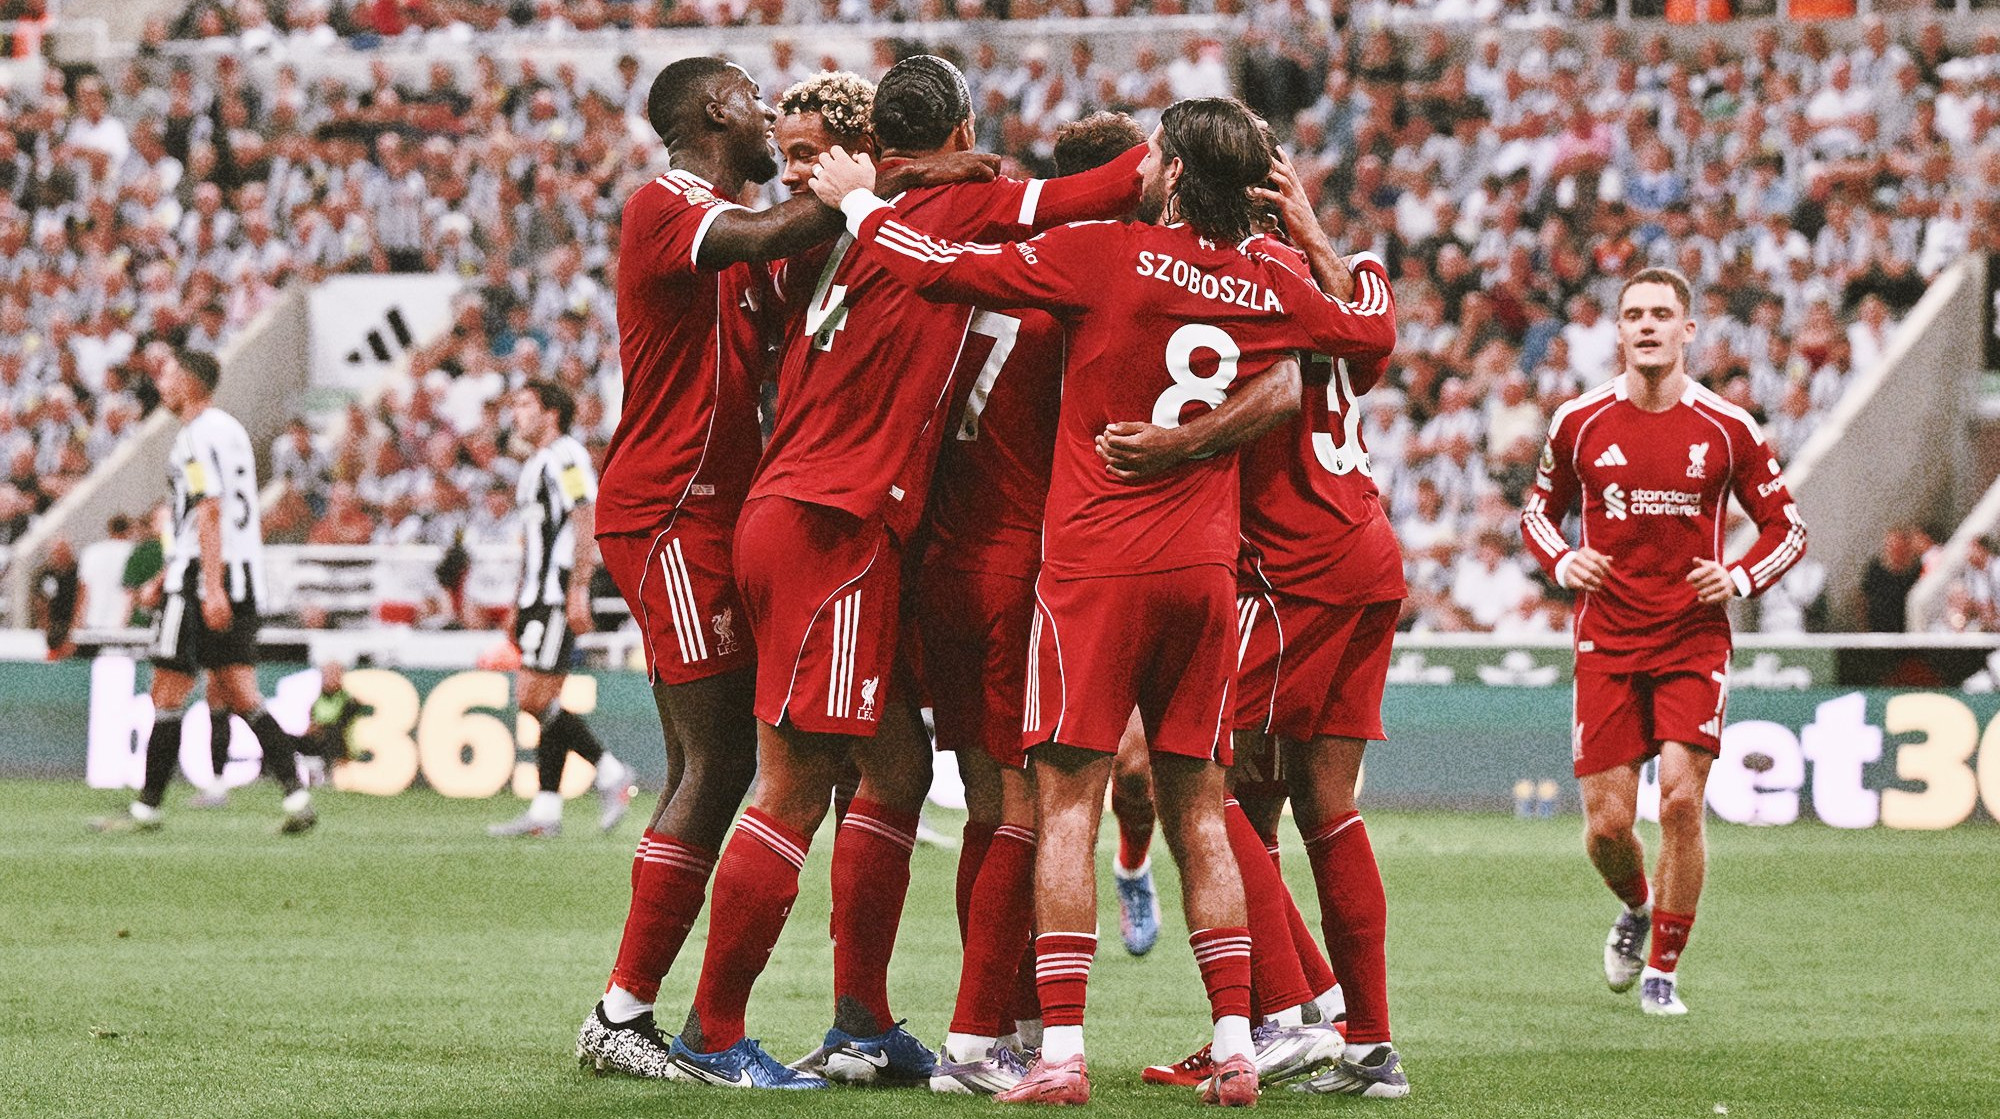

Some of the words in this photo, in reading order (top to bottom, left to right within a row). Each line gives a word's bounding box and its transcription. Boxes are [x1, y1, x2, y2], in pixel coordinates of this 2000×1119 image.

[1136, 250, 1285, 315] SZOBOSZLA
[956, 308, 1022, 442] 7
[1151, 323, 1241, 460] 8
[1630, 489, 1702, 505] standard
[1630, 502, 1702, 517] chartered
[1636, 690, 2000, 831] et3
